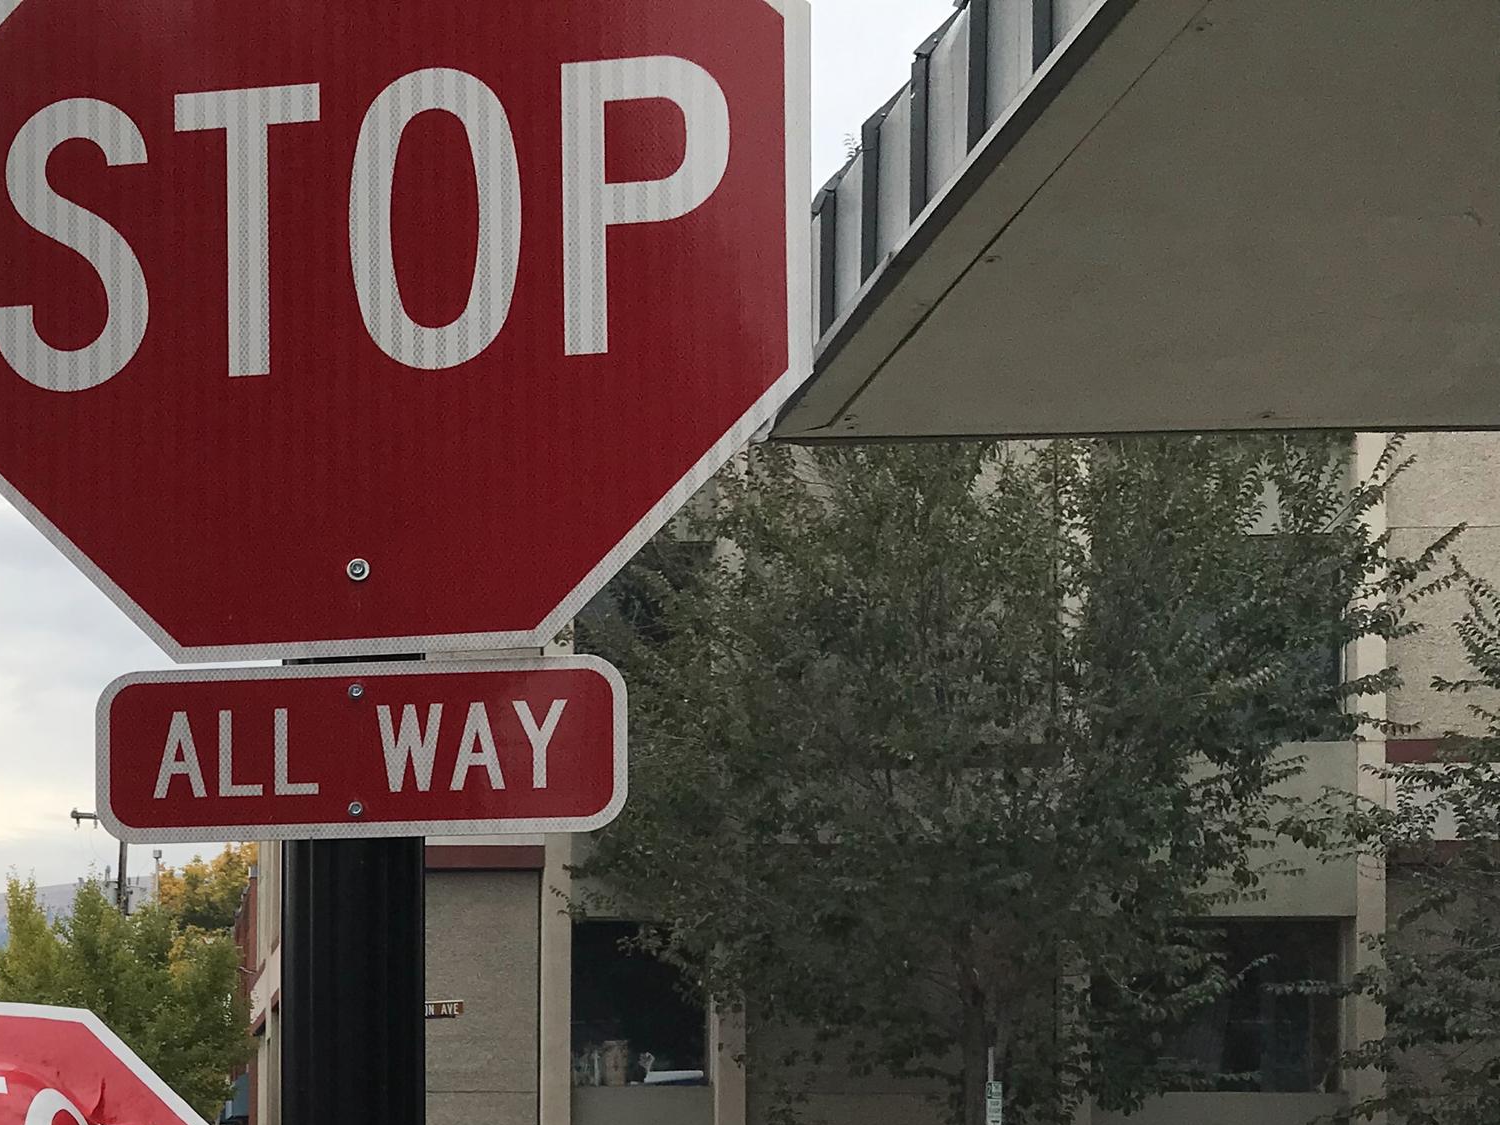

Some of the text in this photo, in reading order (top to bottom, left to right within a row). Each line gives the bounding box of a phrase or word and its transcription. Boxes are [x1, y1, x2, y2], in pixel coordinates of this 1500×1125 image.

[154, 699, 568, 799] ALL WAY
[441, 1003, 459, 1015] AVE
